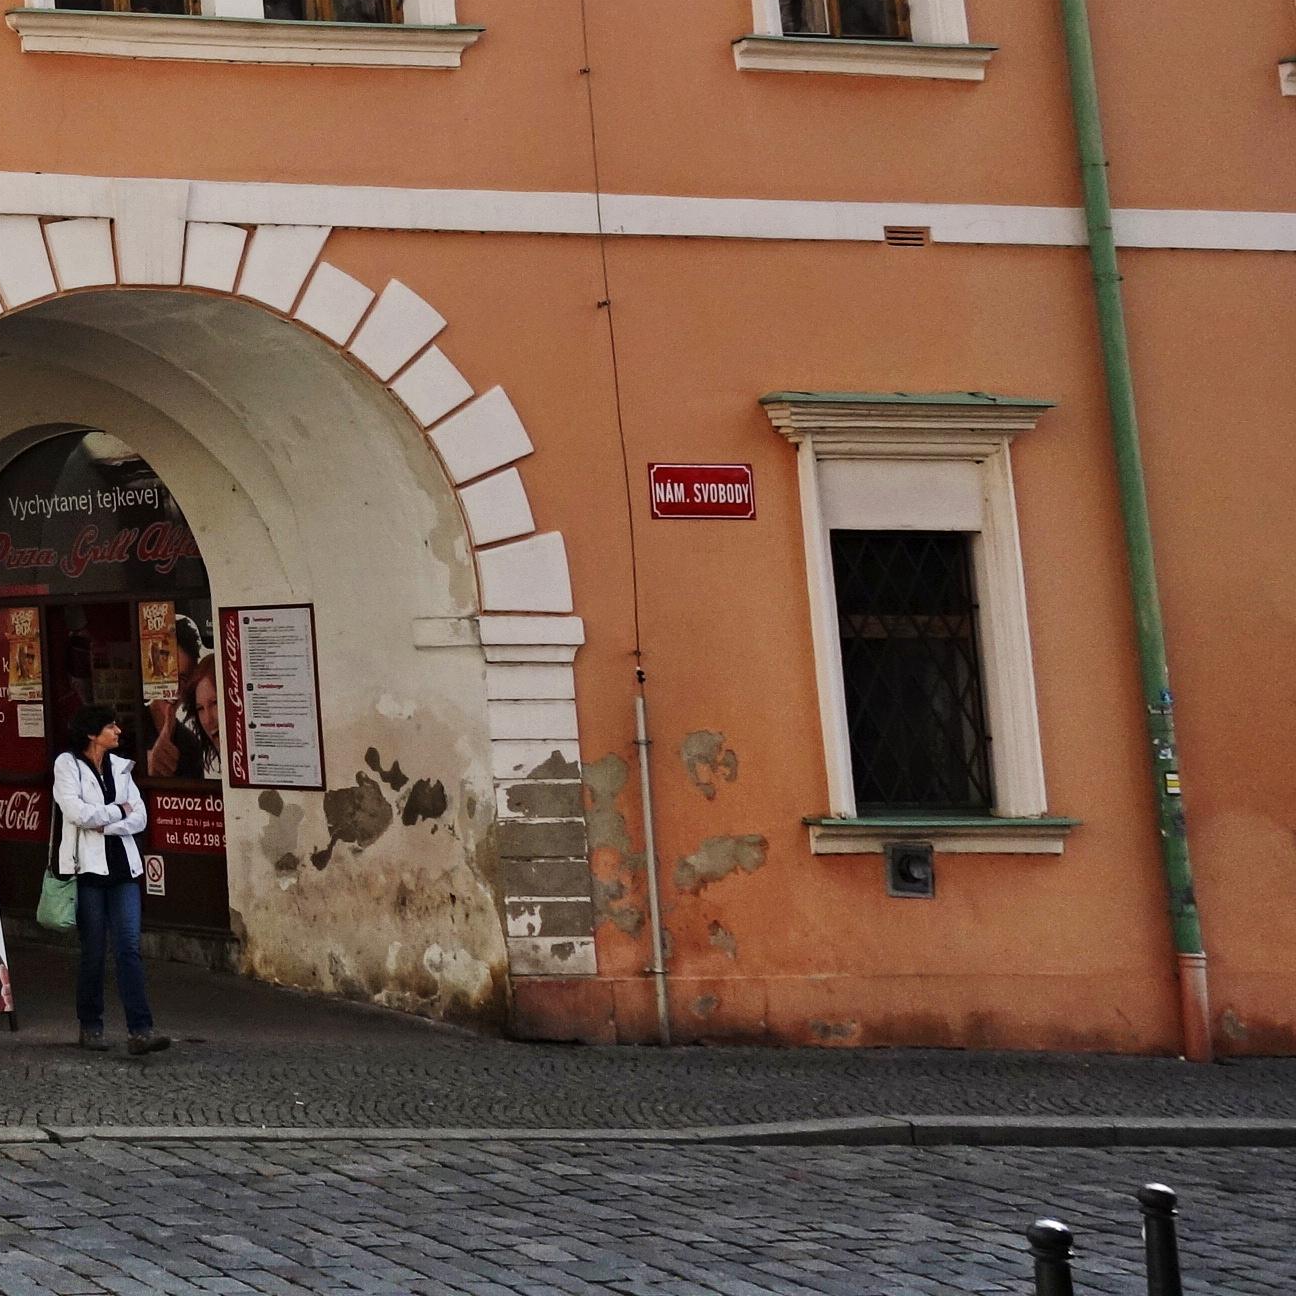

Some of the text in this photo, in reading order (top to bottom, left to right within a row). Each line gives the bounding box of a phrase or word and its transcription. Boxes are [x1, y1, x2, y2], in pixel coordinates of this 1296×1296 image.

[8, 484, 159, 521] Vychytanej tejkevej
[655, 479, 749, 504] NÁM. SVOBODY
[60, 524, 140, 578] Grill
[225, 615, 246, 781] Pizza Grill Alfa
[156, 794, 223, 812] rozvoz do
[166, 831, 181, 844] tel.
[182, 832, 201, 846] 602
[203, 833, 220, 847] 198
